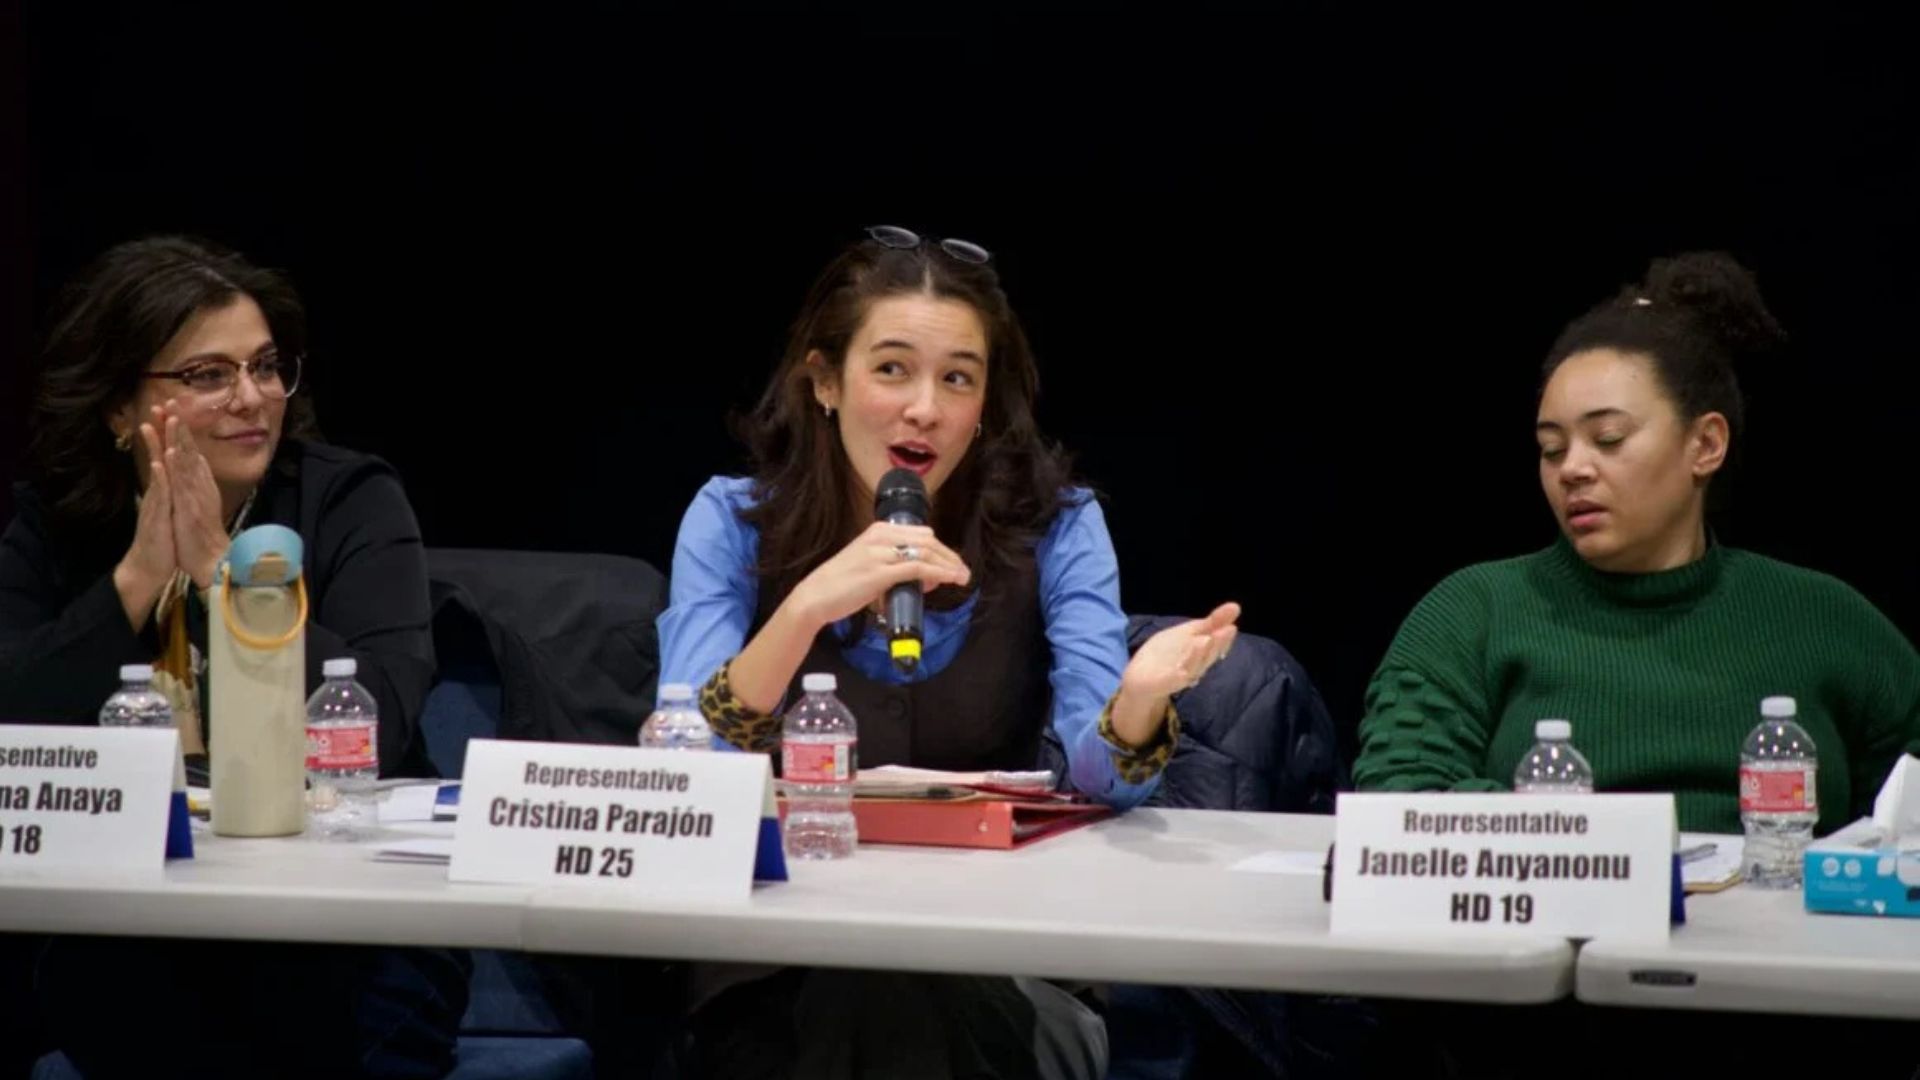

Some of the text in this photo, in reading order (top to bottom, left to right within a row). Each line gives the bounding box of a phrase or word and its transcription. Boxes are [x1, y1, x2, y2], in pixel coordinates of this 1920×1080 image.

[523, 761, 690, 793] Representative
[35, 782, 123, 814] Anaya
[488, 797, 714, 838] Cristina Parajón
[1403, 810, 1589, 836] Representative
[10, 825, 42, 854] 18
[555, 845, 634, 878] HD 25
[1358, 847, 1631, 881] Janelle Anyanonu
[1450, 893, 1534, 924] HD 19
